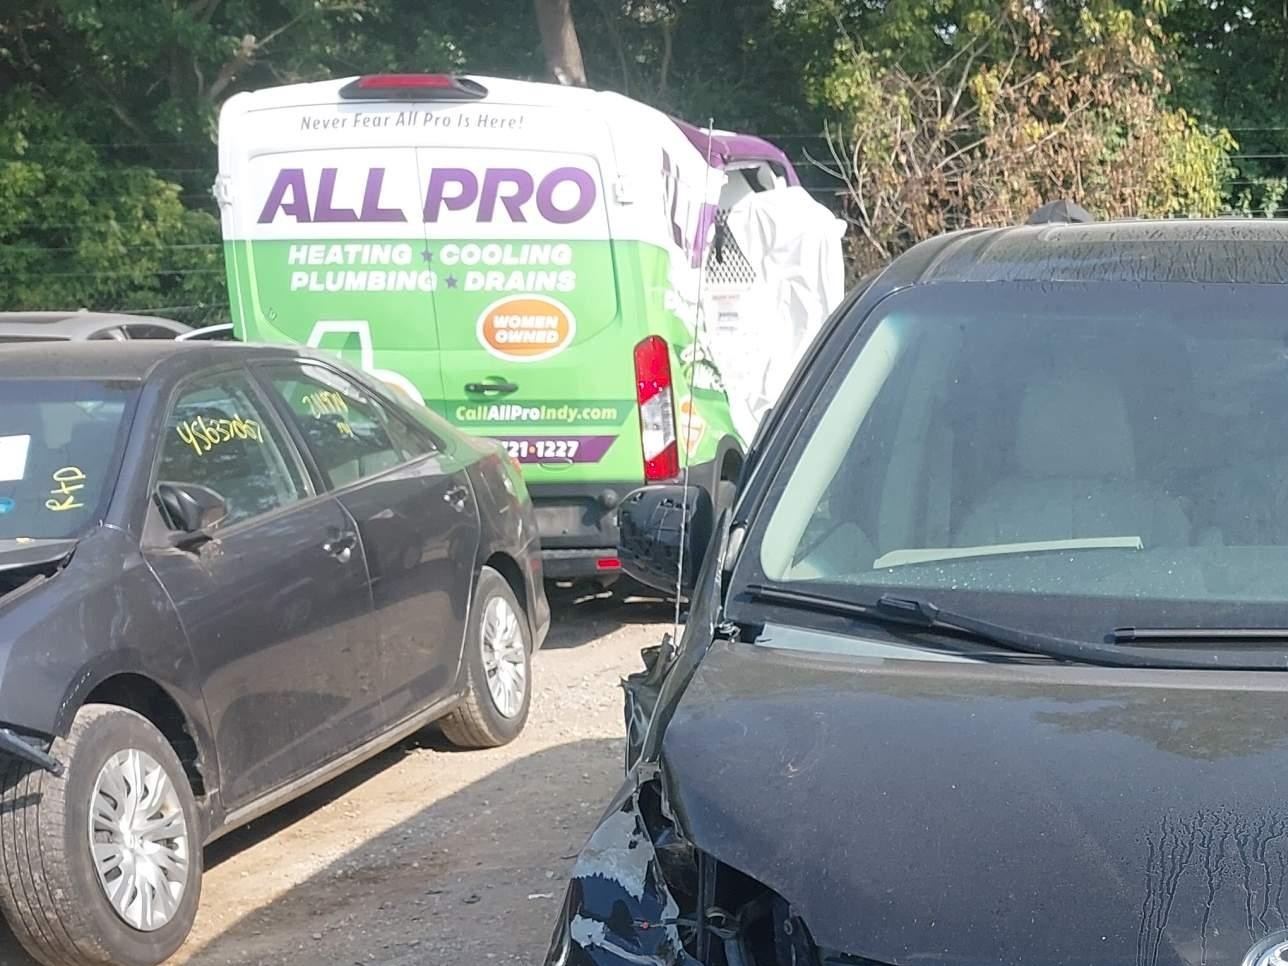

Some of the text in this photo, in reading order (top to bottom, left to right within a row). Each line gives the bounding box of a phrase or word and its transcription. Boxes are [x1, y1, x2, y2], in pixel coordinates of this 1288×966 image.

[300, 111, 524, 130] Never Fear All Pro Is Here!
[257, 166, 597, 225] ALL PRO
[288, 244, 572, 265] HEATING COOLING
[290, 270, 577, 292] PLUMBING DRAINS
[493, 315, 559, 329] WOMEN
[496, 329, 560, 344] OWNED
[456, 405, 617, 422] CallAllProIndy.com
